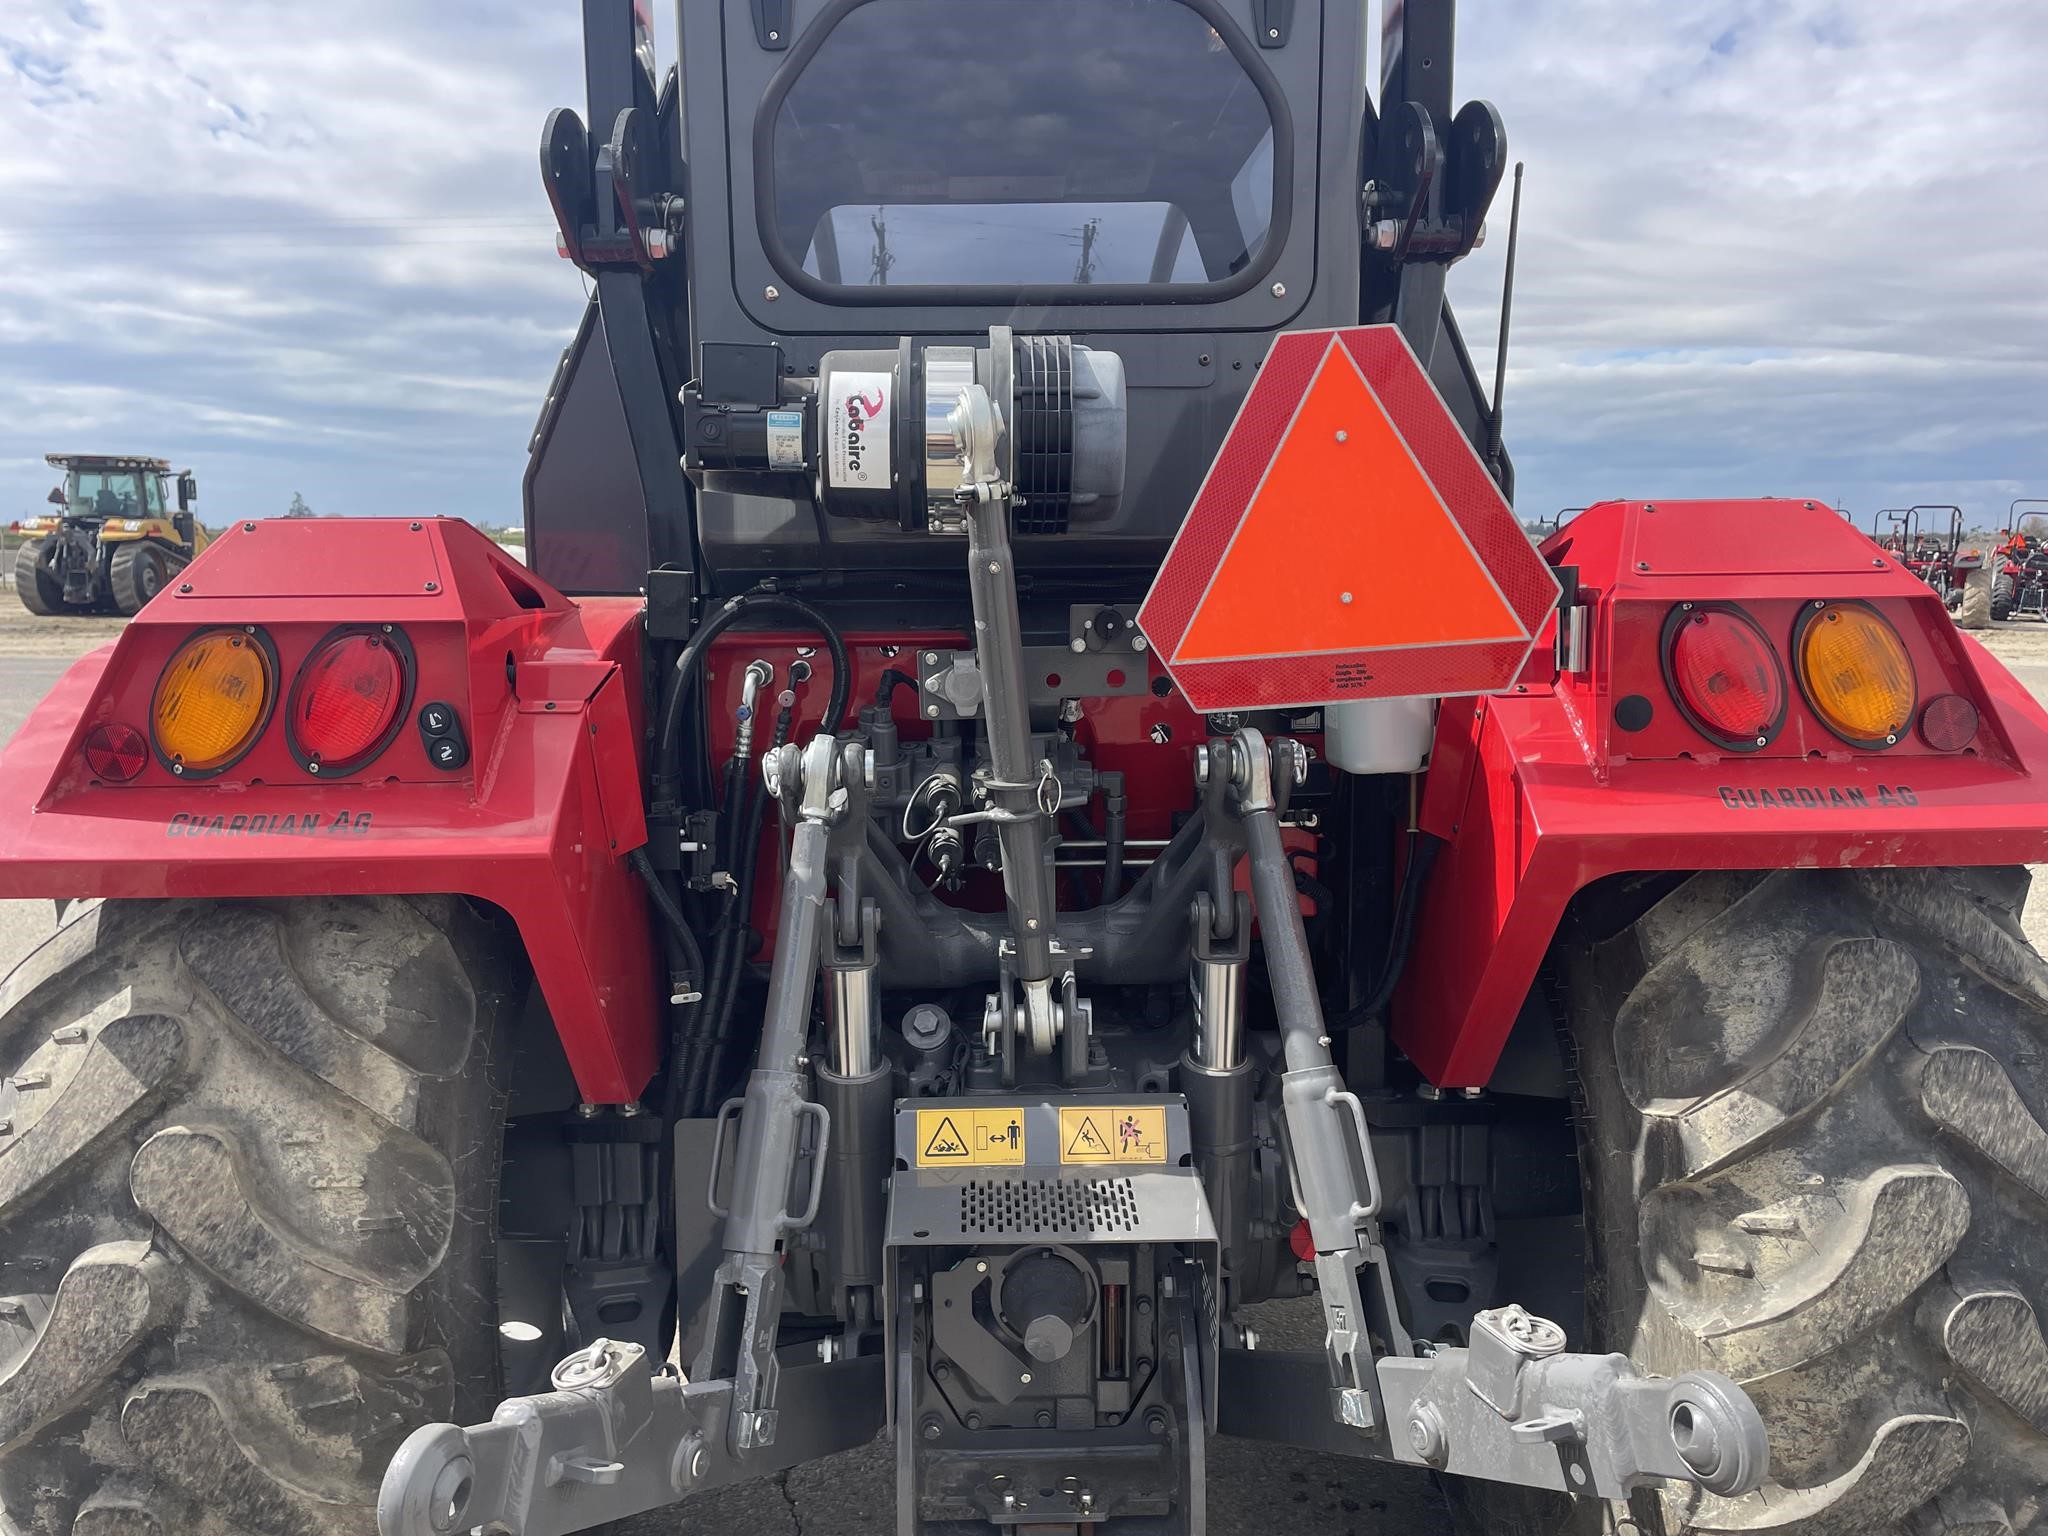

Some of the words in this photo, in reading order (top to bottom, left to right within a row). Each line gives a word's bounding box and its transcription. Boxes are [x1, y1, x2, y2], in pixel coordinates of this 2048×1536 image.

[848, 395, 866, 472] Cabaire
[1717, 785, 1870, 810] GUARDIAN
[166, 812, 321, 838] GUARDIAN
